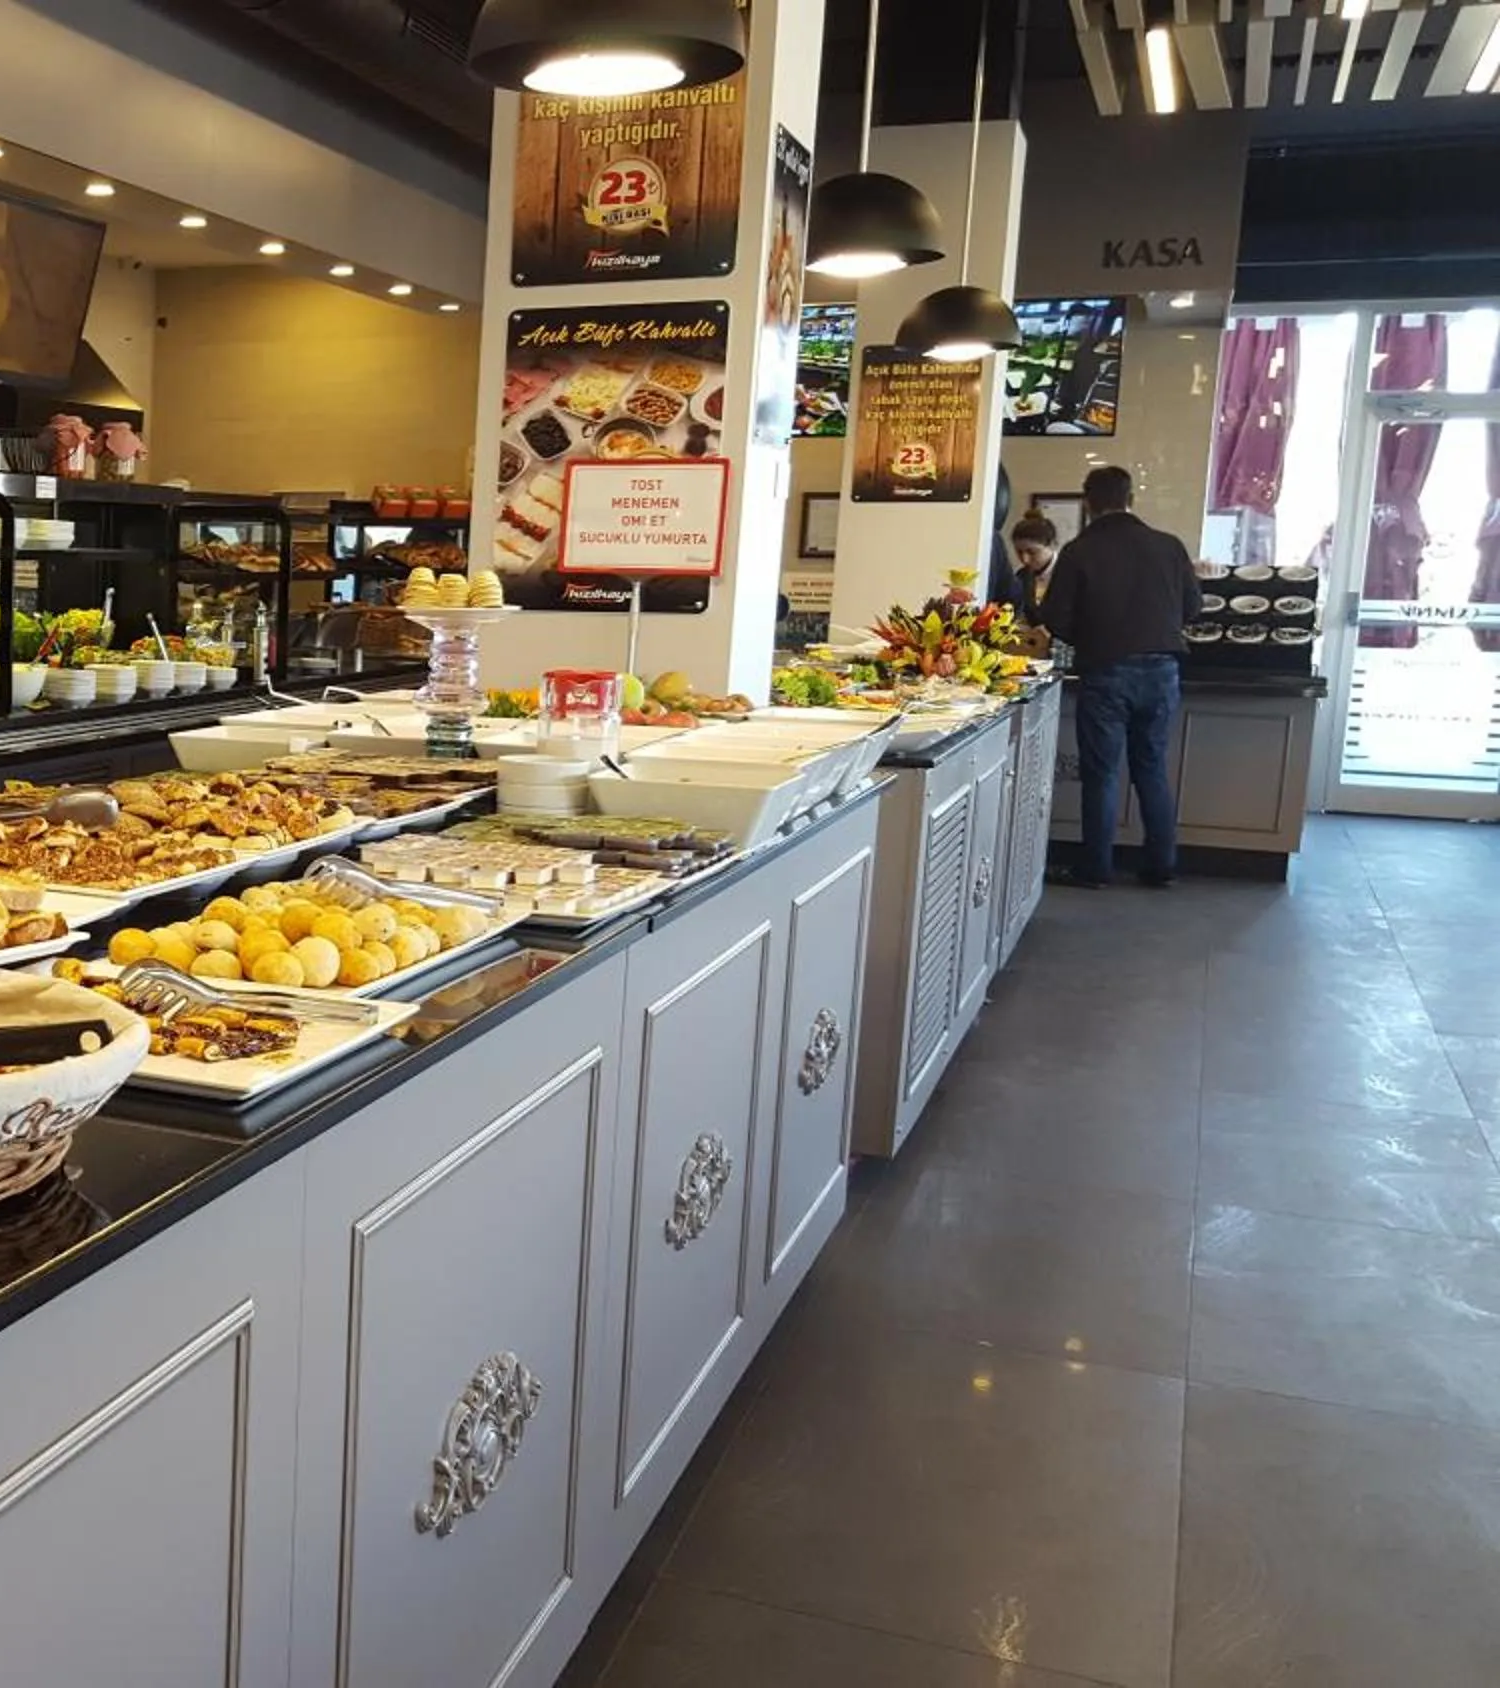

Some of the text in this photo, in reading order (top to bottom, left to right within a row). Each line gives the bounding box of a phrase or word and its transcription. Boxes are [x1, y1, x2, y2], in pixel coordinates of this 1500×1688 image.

[534, 99, 569, 122] kaç
[1101, 237, 1204, 269] KASA
[630, 479, 663, 491] TOST
[611, 497, 679, 509] MENEMEN
[579, 530, 708, 545] SUCUKLU YUMURTA
